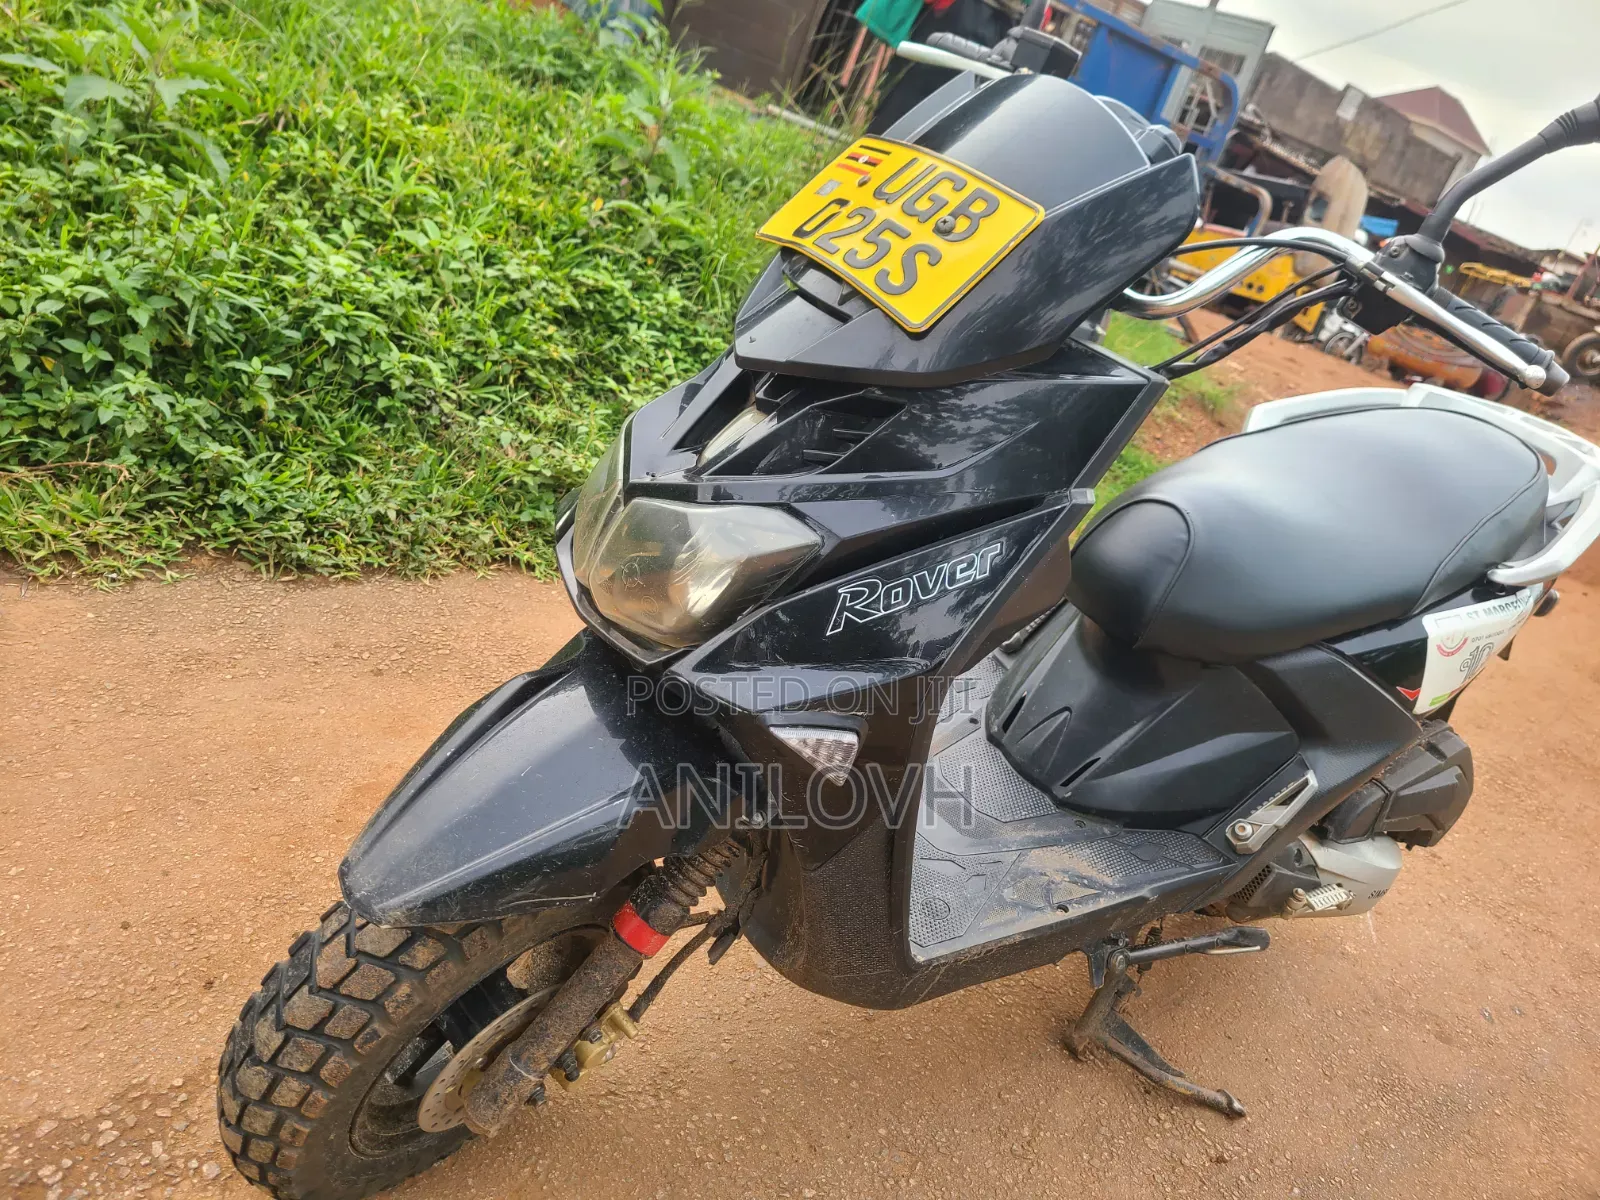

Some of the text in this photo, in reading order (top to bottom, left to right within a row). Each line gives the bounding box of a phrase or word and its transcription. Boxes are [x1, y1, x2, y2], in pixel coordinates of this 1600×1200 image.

[872, 157, 1000, 242] UGB
[791, 198, 943, 296] 025S
[826, 542, 1004, 636] Rover
